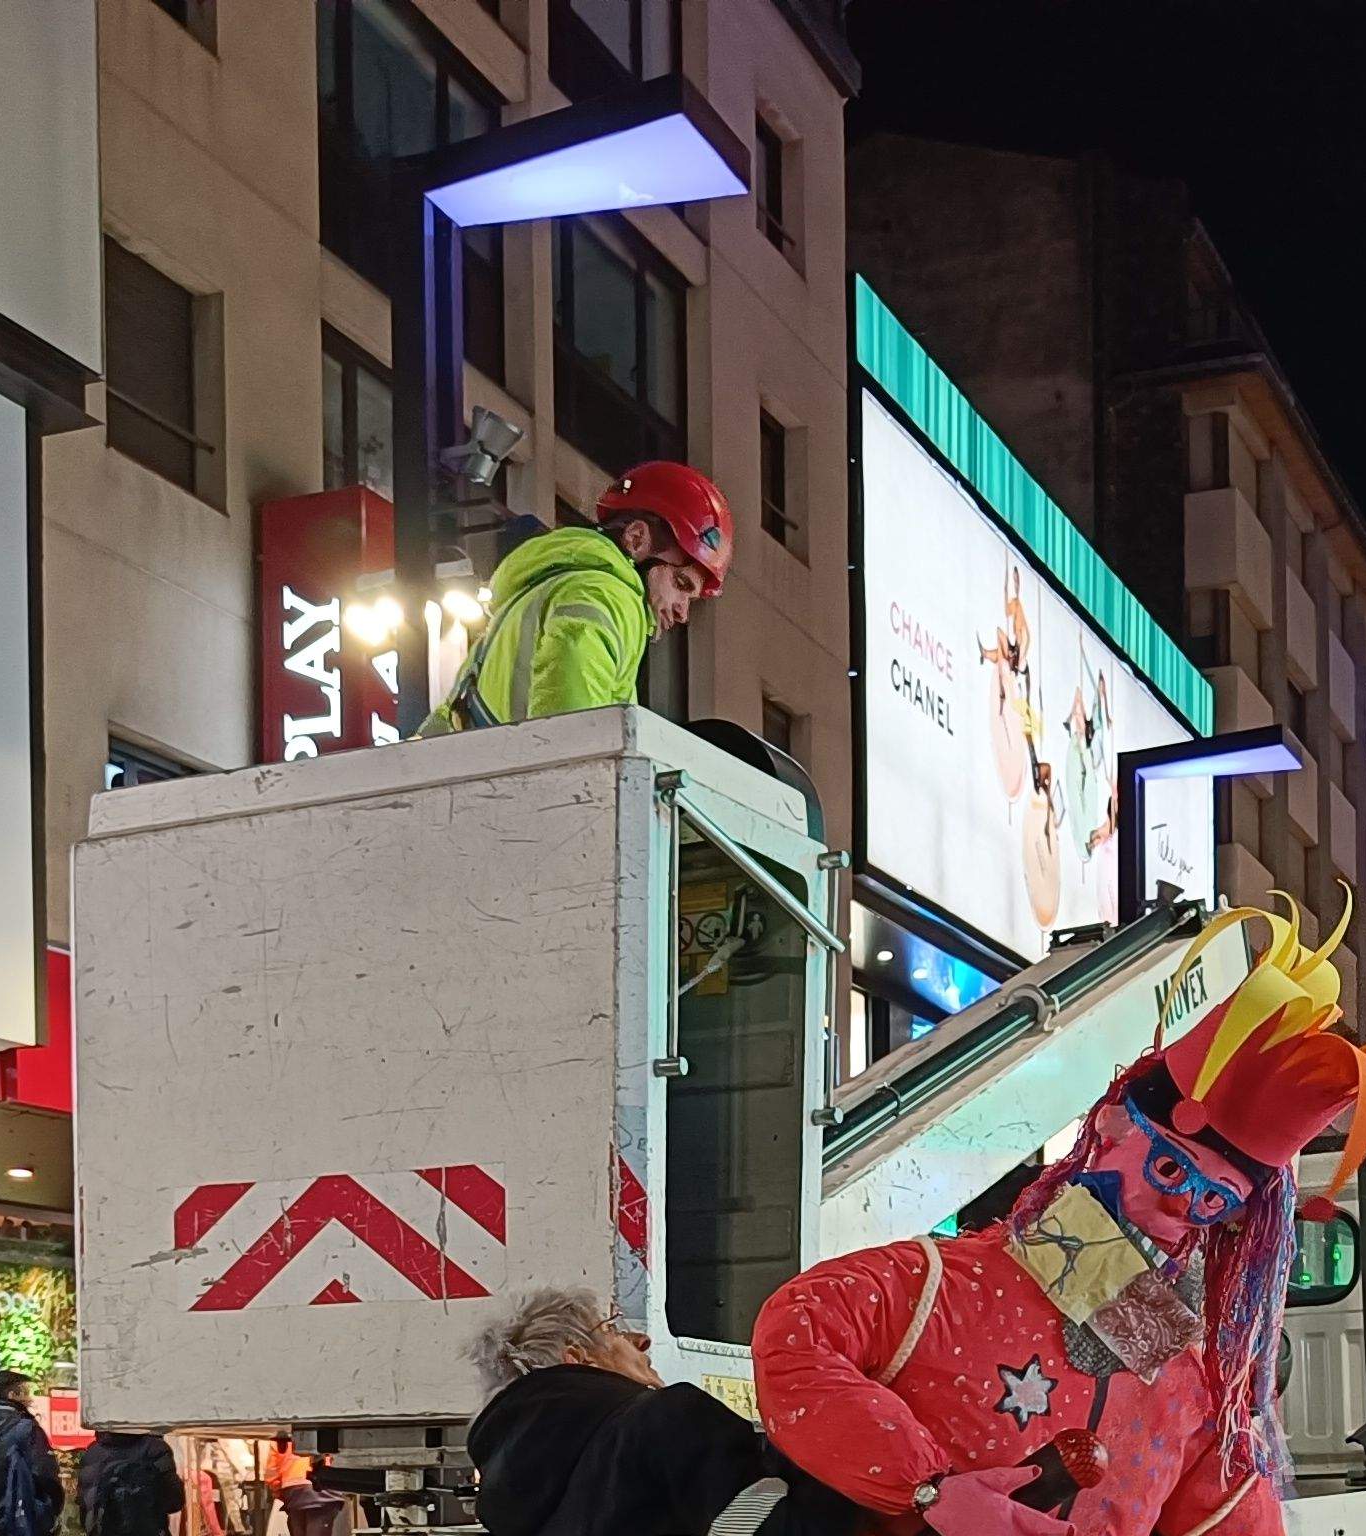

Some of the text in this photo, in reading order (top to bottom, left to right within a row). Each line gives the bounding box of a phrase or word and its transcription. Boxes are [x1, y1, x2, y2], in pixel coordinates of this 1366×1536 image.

[890, 601, 953, 682] CHANCE
[891, 658, 954, 736] CHANEL
[1154, 955, 1208, 1030] MOVEX
